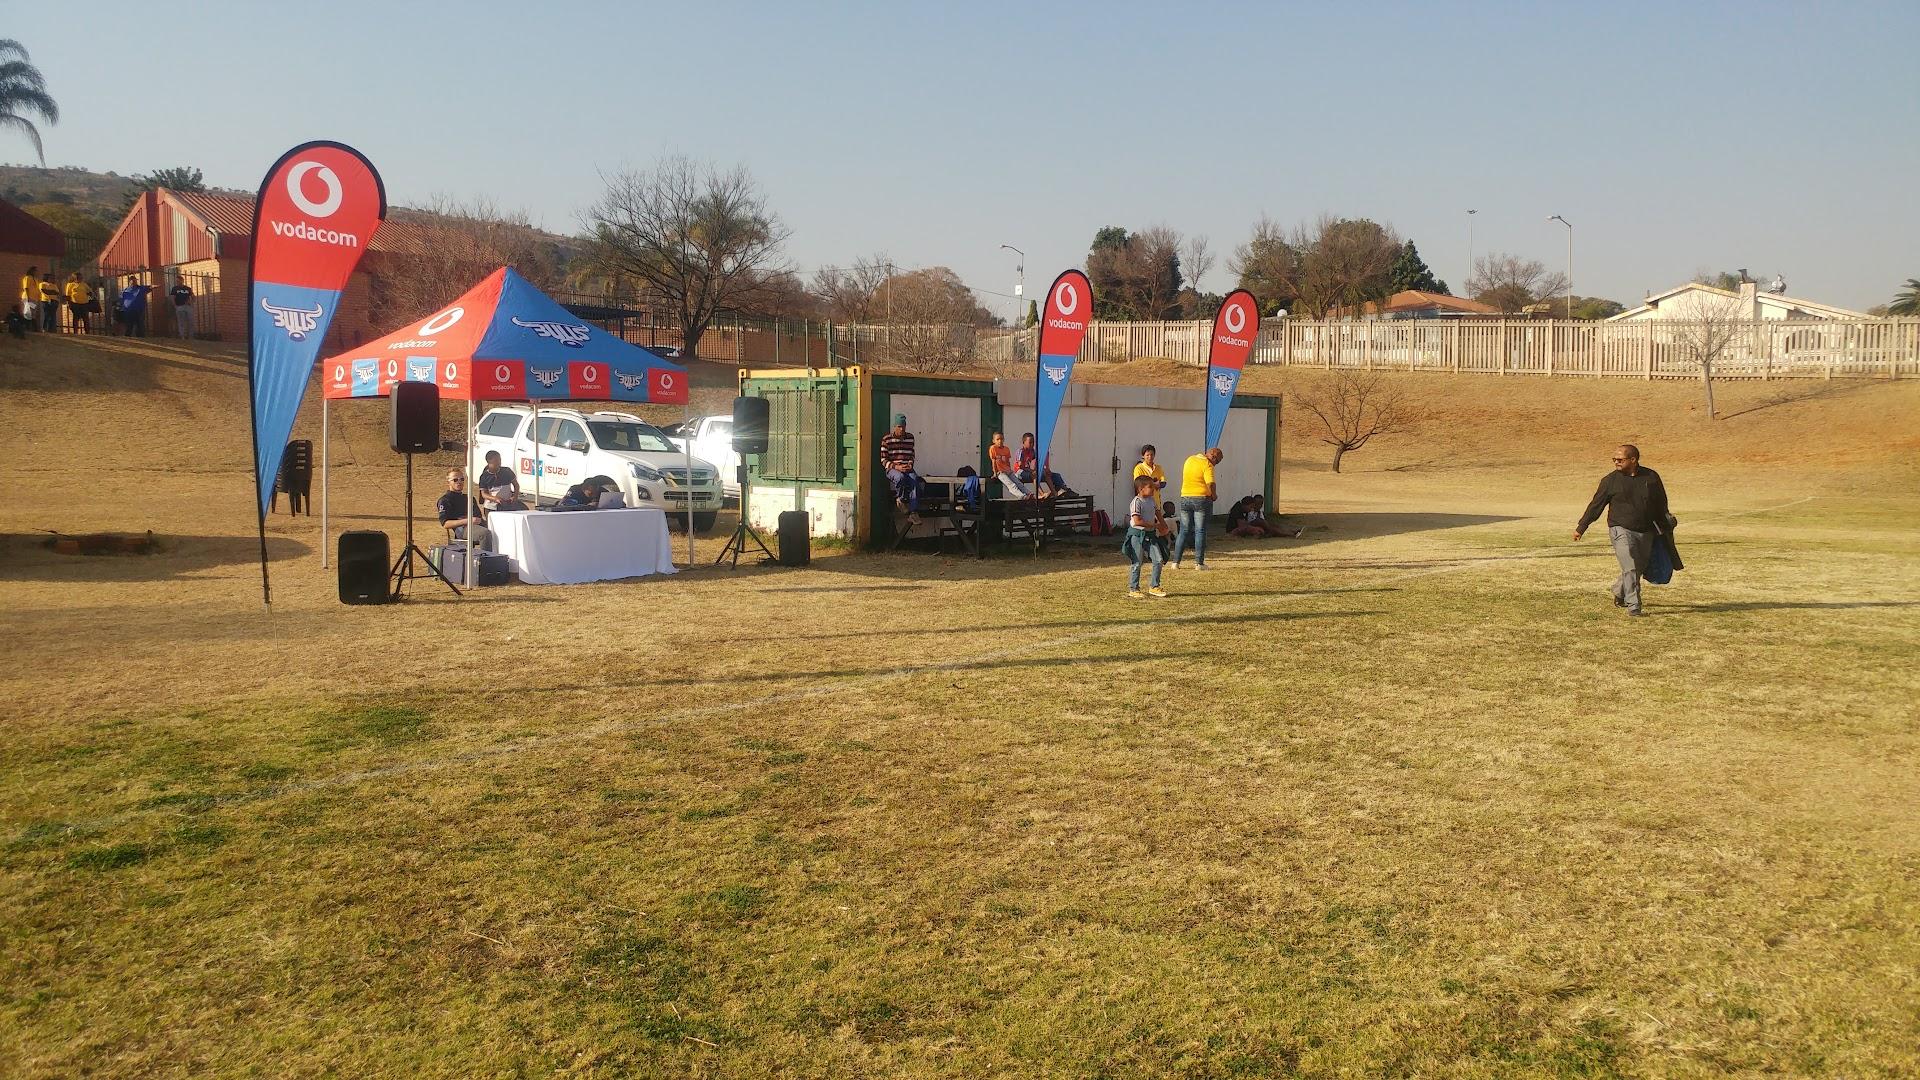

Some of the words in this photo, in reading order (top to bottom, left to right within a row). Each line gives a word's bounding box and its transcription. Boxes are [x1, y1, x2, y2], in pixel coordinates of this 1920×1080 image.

[271, 220, 357, 248] vodacom
[1049, 318, 1083, 331] vodacom
[387, 339, 438, 350] vodacom
[1218, 335, 1249, 347] vodacom
